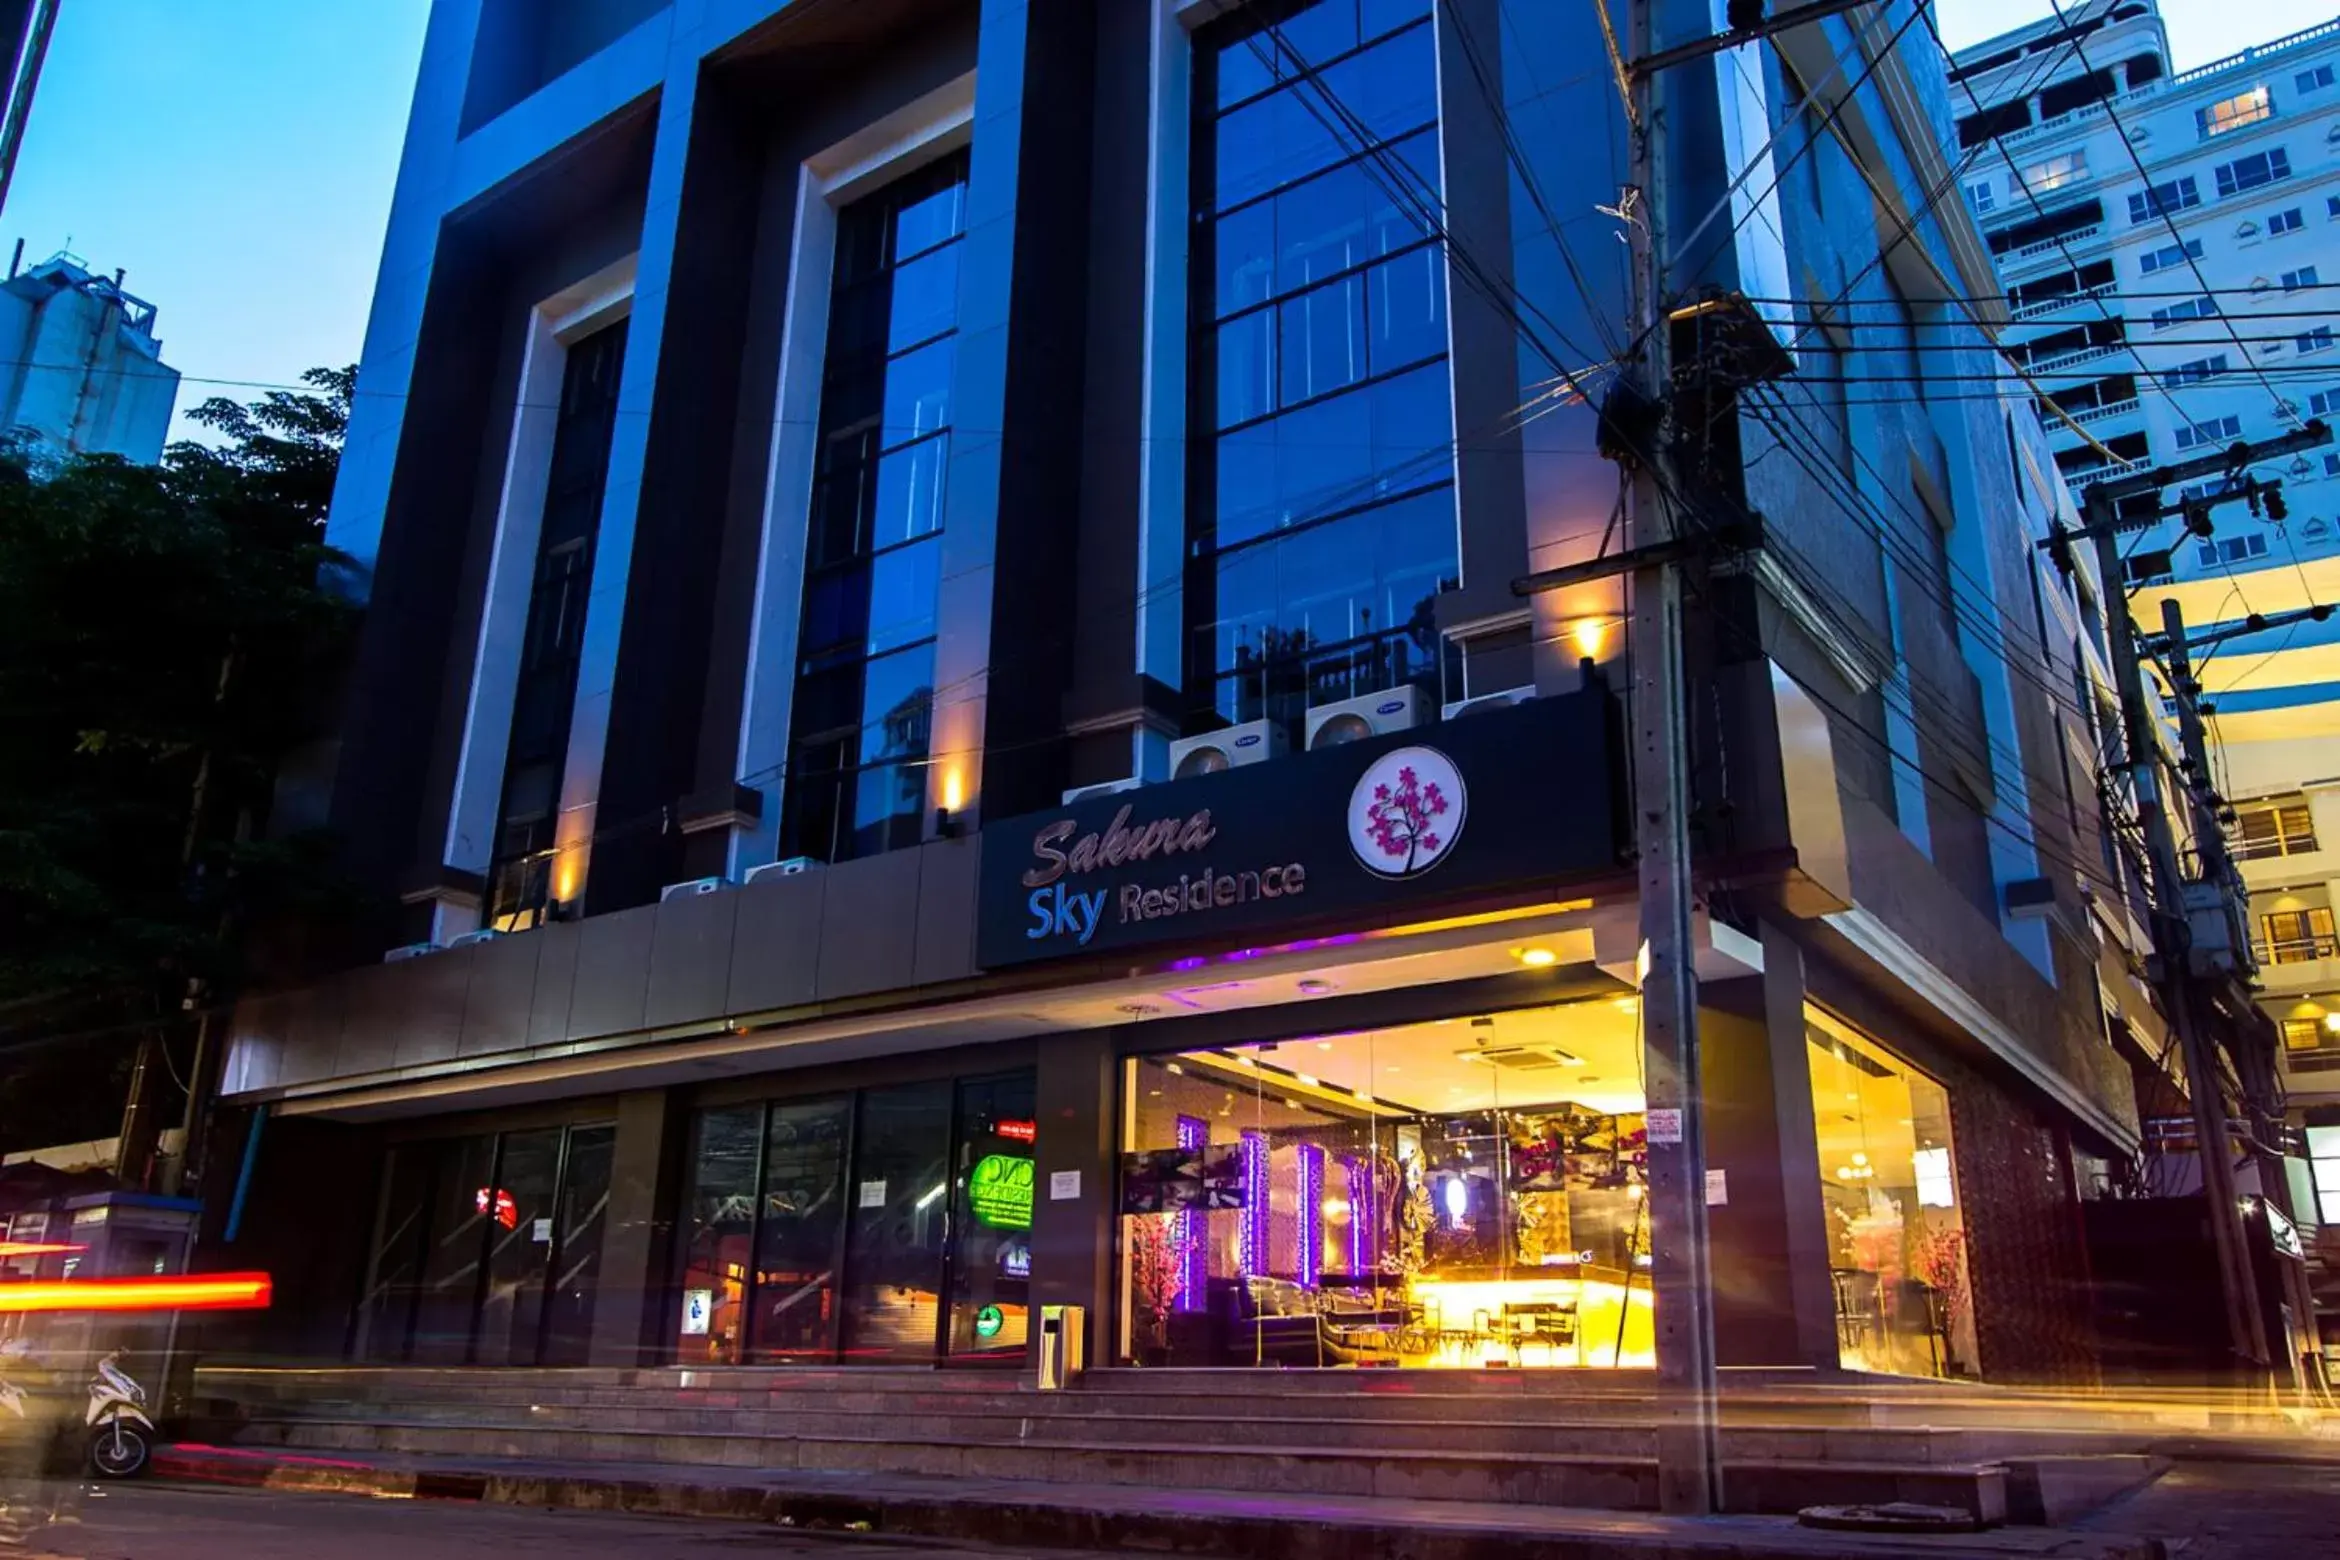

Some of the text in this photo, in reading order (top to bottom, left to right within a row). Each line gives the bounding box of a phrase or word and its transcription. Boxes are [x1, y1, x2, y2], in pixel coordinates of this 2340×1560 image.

[1022, 803, 1217, 888] Sakura
[1026, 862, 1306, 945] Sky Residence
